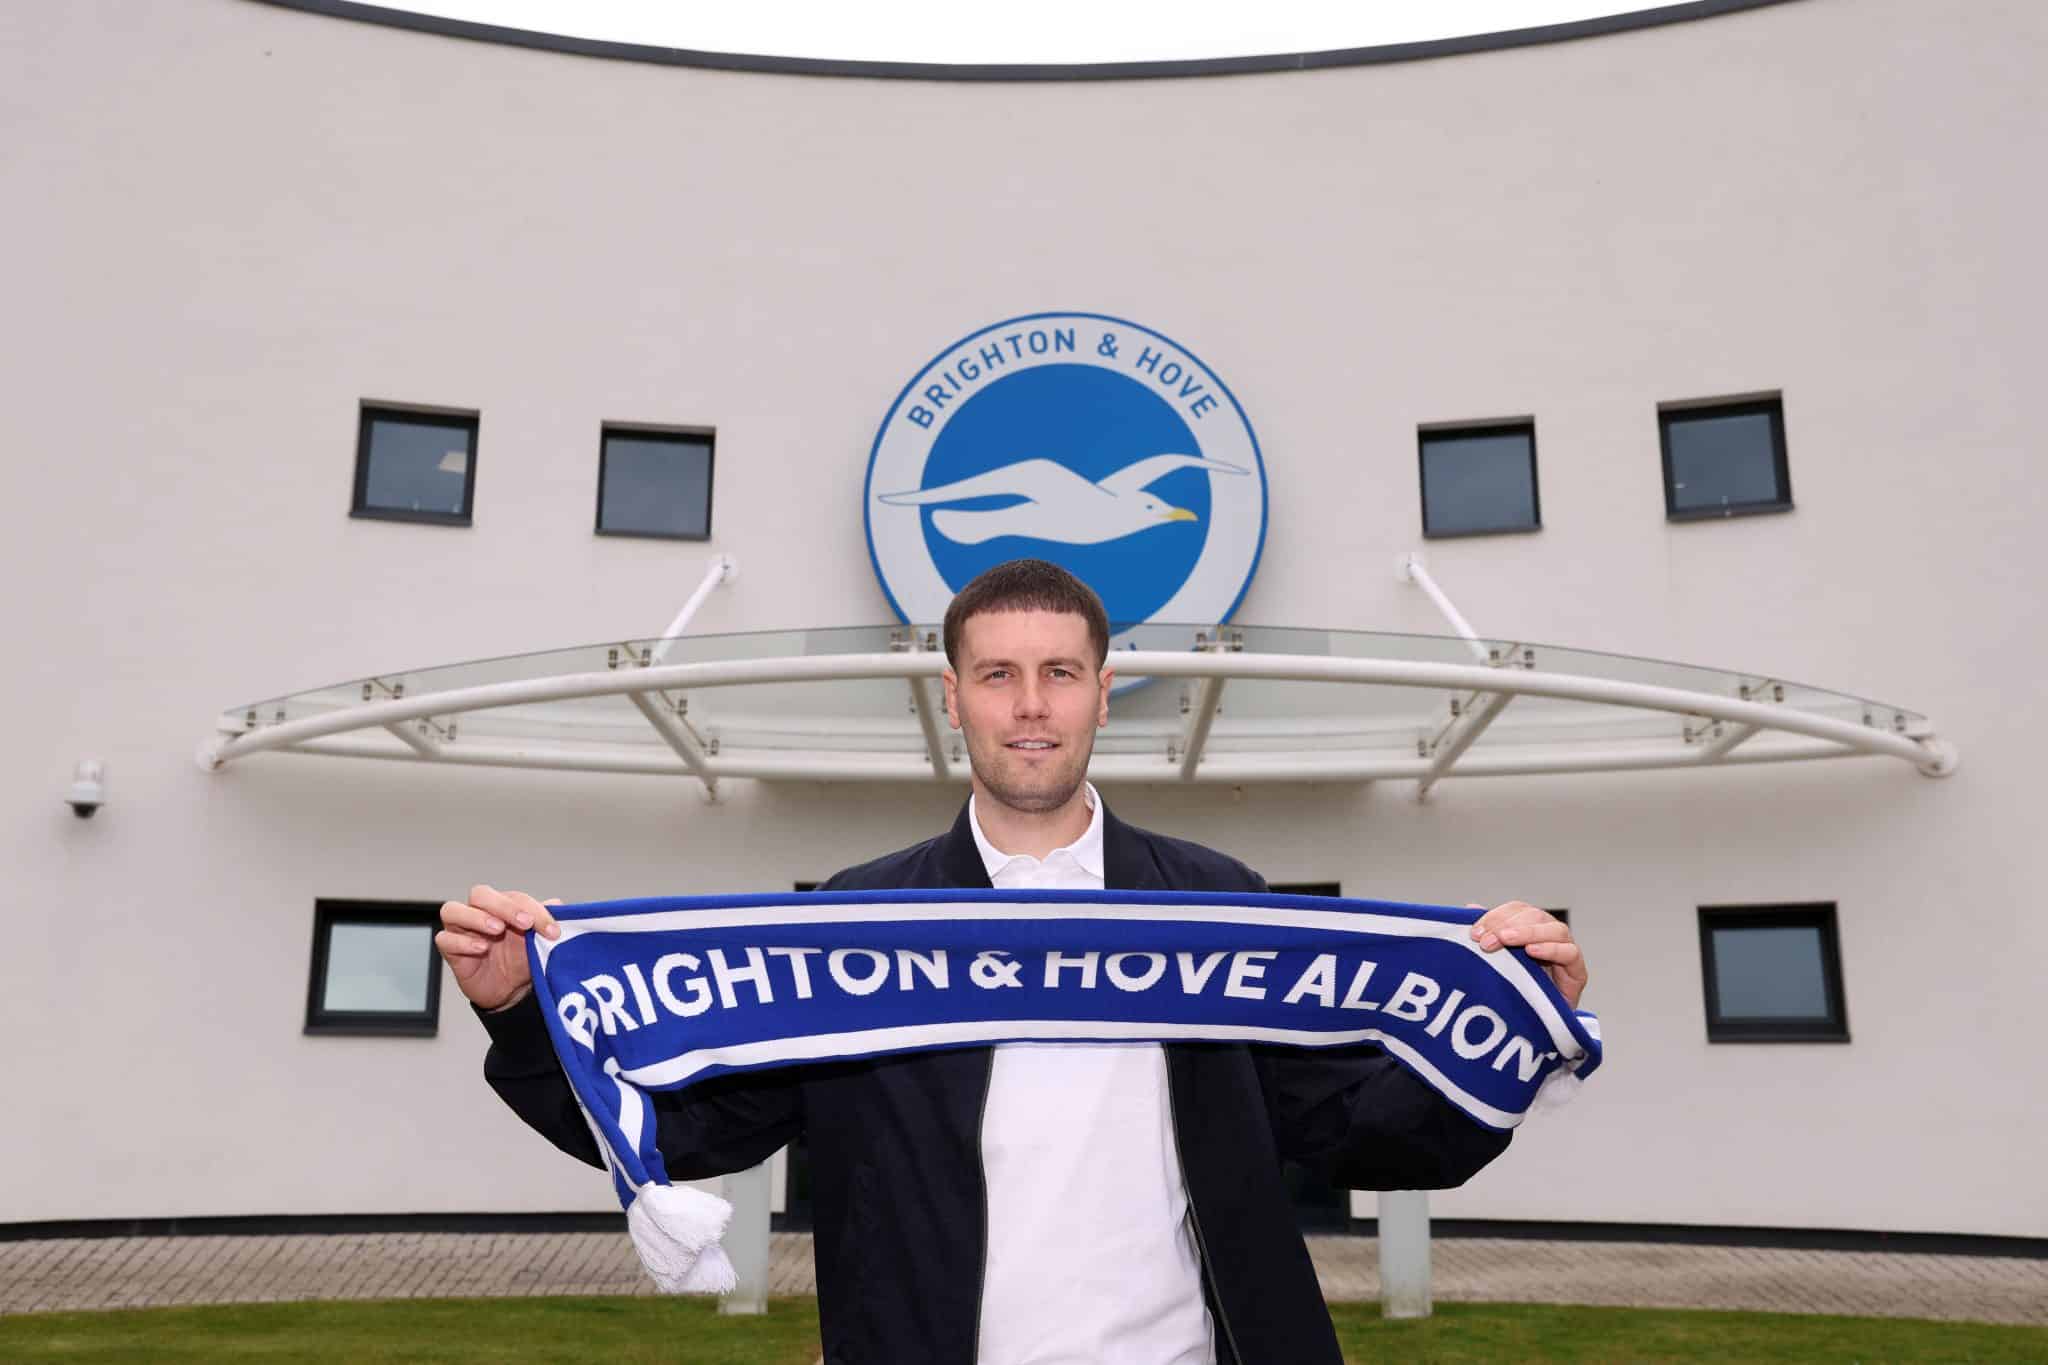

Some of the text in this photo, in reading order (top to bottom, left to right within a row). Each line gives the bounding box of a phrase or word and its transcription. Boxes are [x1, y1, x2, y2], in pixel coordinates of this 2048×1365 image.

[907, 327, 1218, 429] BRIGHTON & HOVE
[557, 947, 1554, 1082] BRIGHTON & HOVE ALBION
